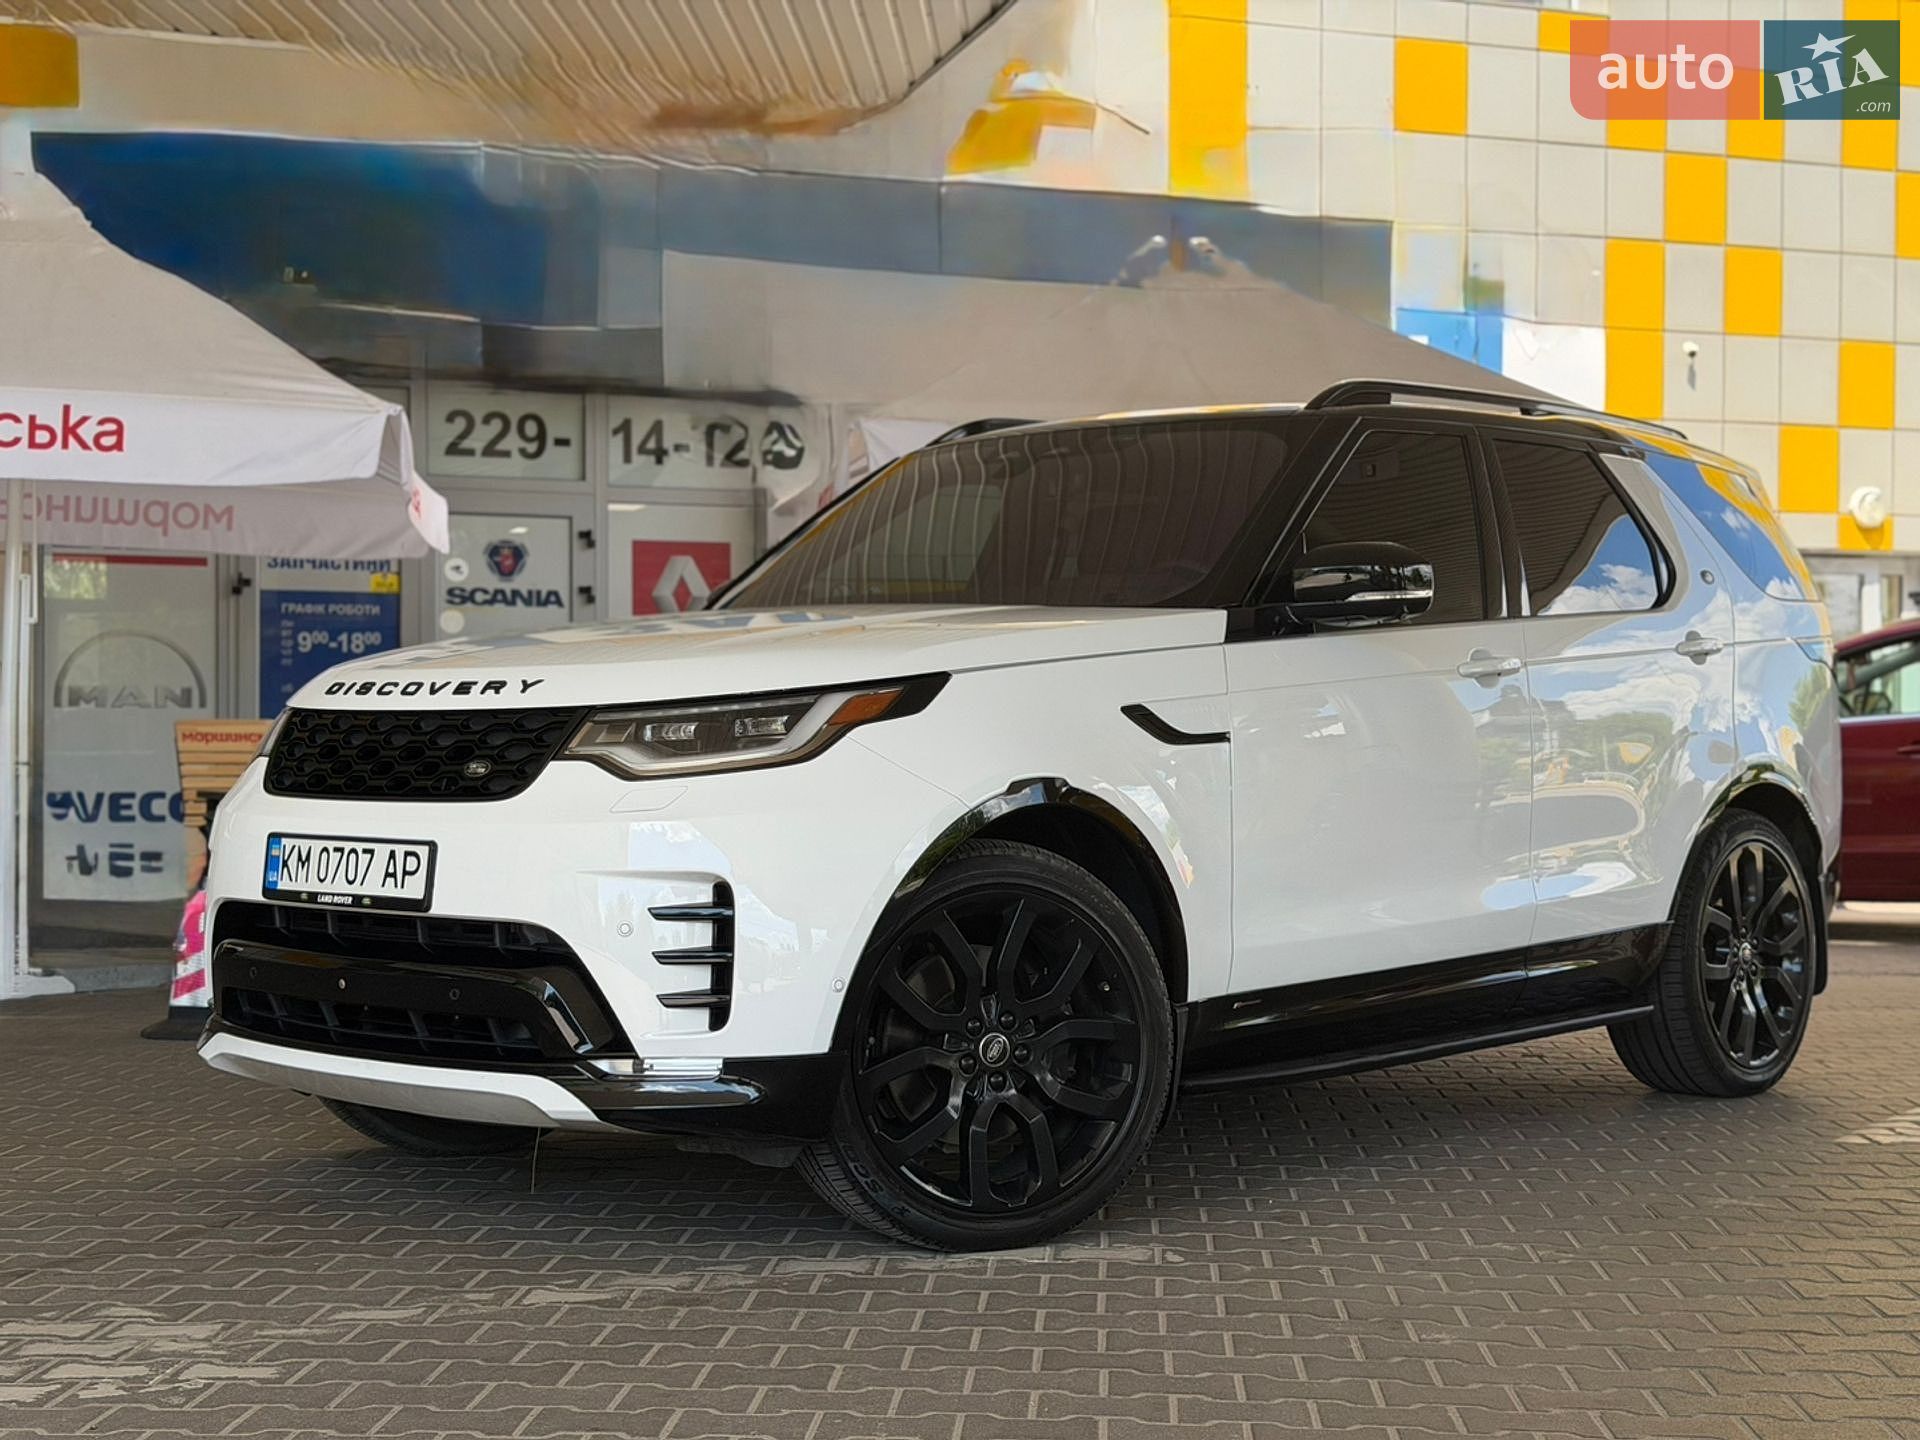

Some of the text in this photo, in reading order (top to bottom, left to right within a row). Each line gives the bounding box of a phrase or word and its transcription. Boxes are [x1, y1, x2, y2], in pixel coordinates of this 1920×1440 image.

[443, 409, 571, 460] 229-
[446, 586, 564, 608] SCANIA
[328, 603, 380, 616] РОБОТИ
[68, 685, 193, 708] MAN
[325, 679, 544, 696] DISCOVERY
[281, 843, 421, 889] KM 0707 AP
